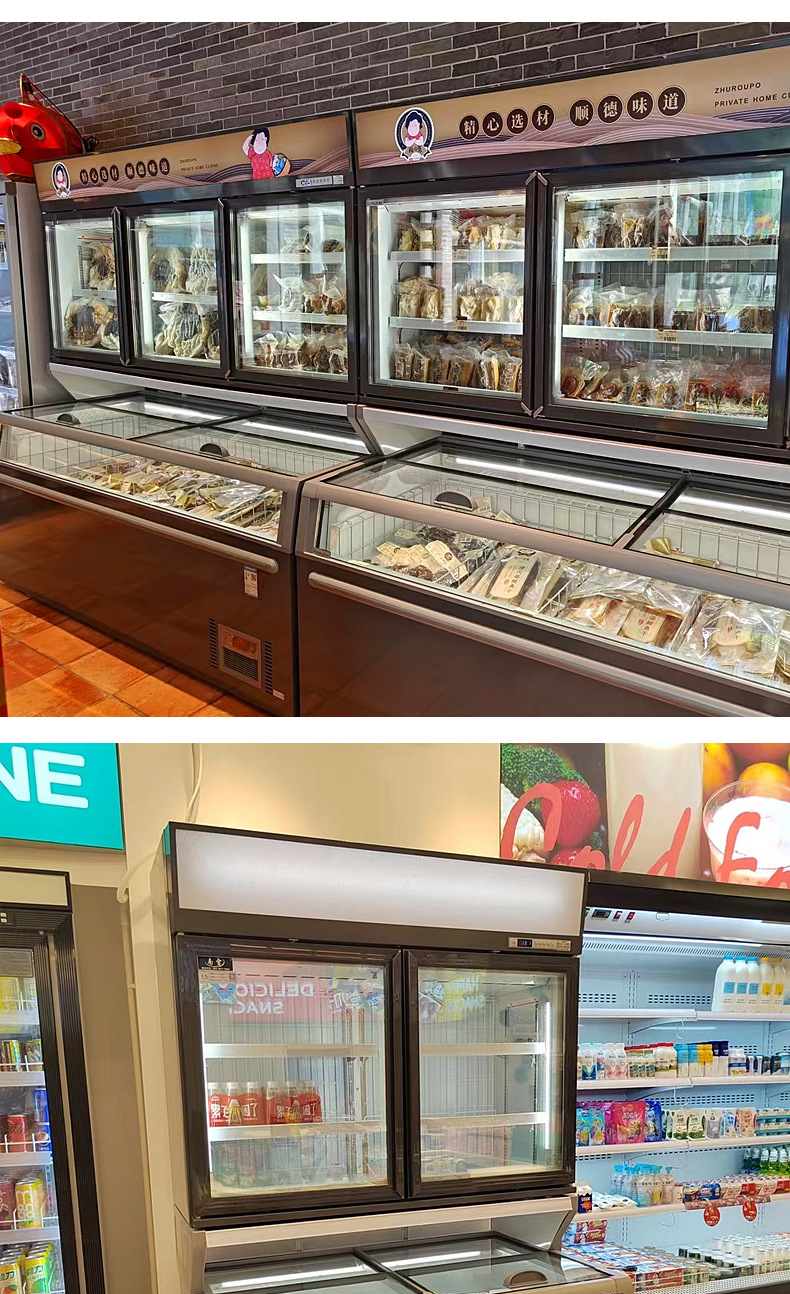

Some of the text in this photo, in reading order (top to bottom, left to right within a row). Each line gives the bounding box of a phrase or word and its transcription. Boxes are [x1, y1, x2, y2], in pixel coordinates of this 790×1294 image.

[714, 82, 761, 94] ZHUROUPO
[714, 97, 749, 107] PRIVATE
[753, 94, 777, 103] HOME
[462, 92, 680, 136] 精心选材 顺德味道
